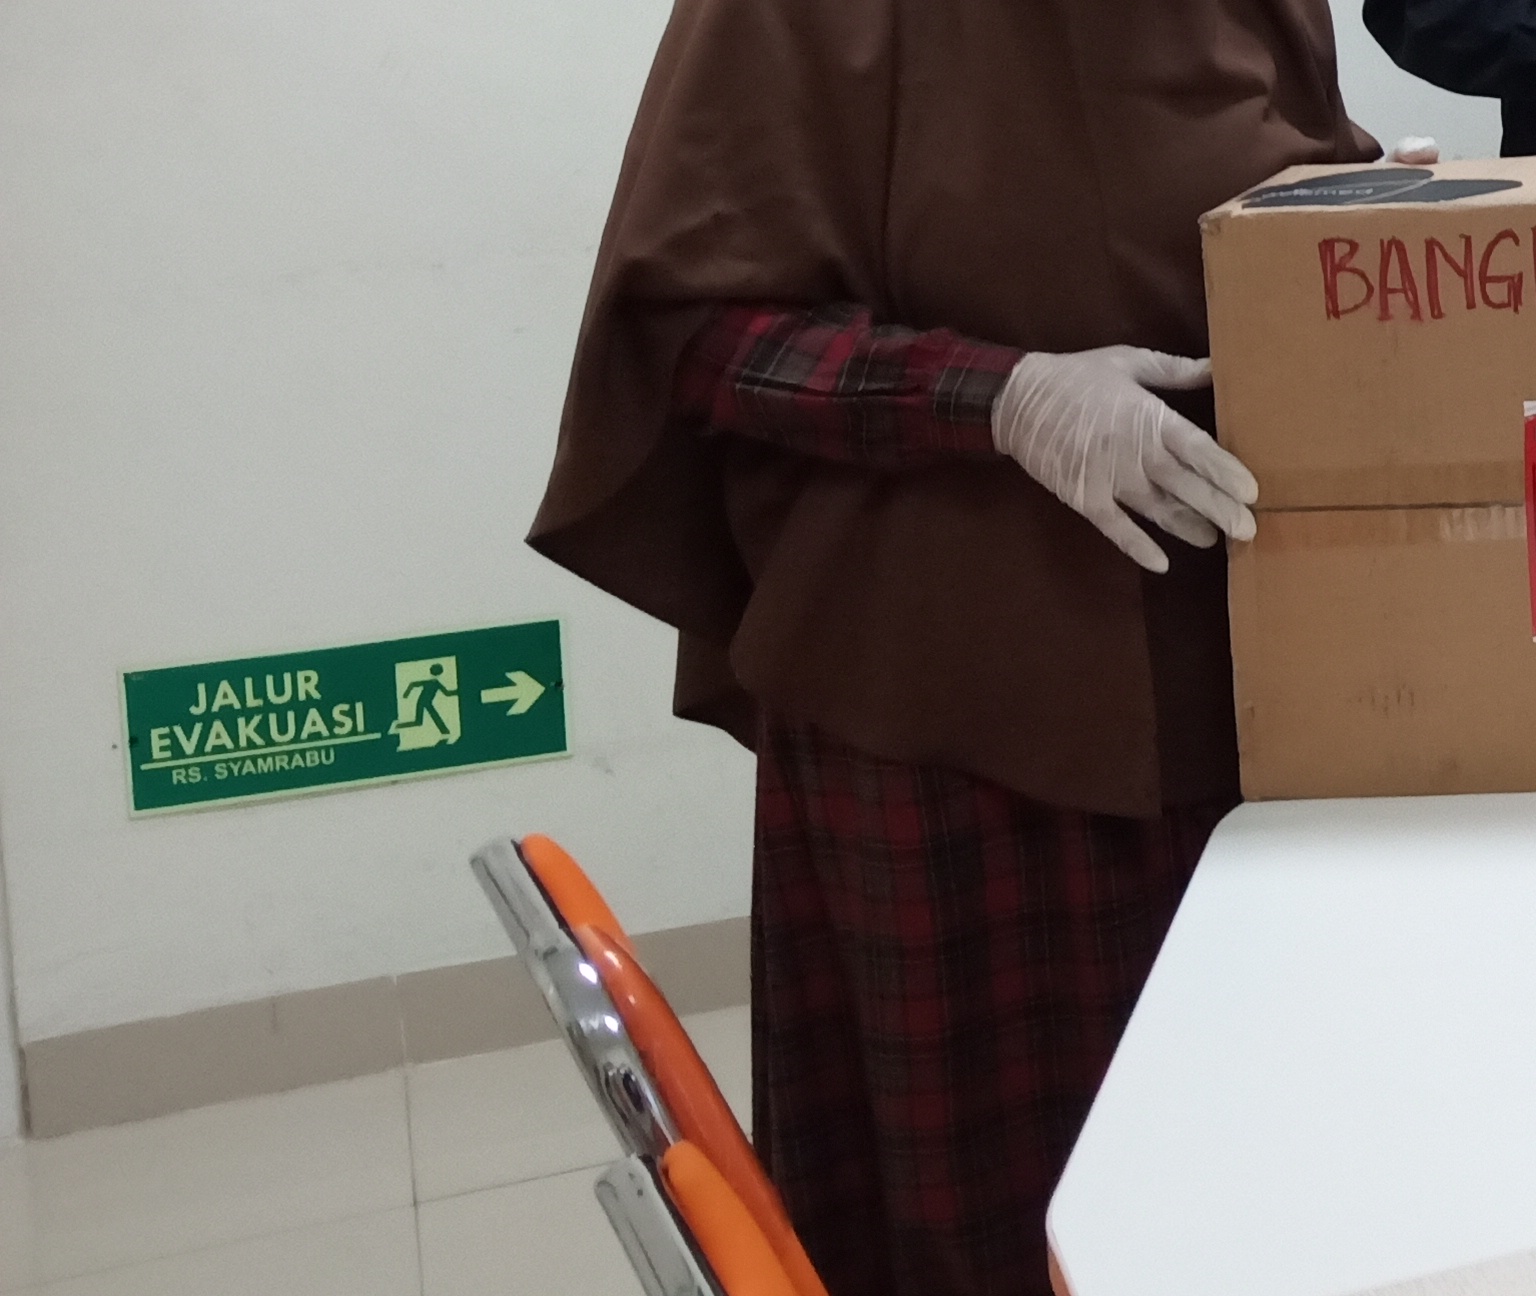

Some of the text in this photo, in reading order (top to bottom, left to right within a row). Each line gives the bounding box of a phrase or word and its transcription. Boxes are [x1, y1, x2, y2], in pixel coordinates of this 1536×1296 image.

[189, 669, 322, 716] JALUR
[150, 701, 366, 760] EVAKUASI
[172, 748, 336, 785] RS. SYAMRABU
